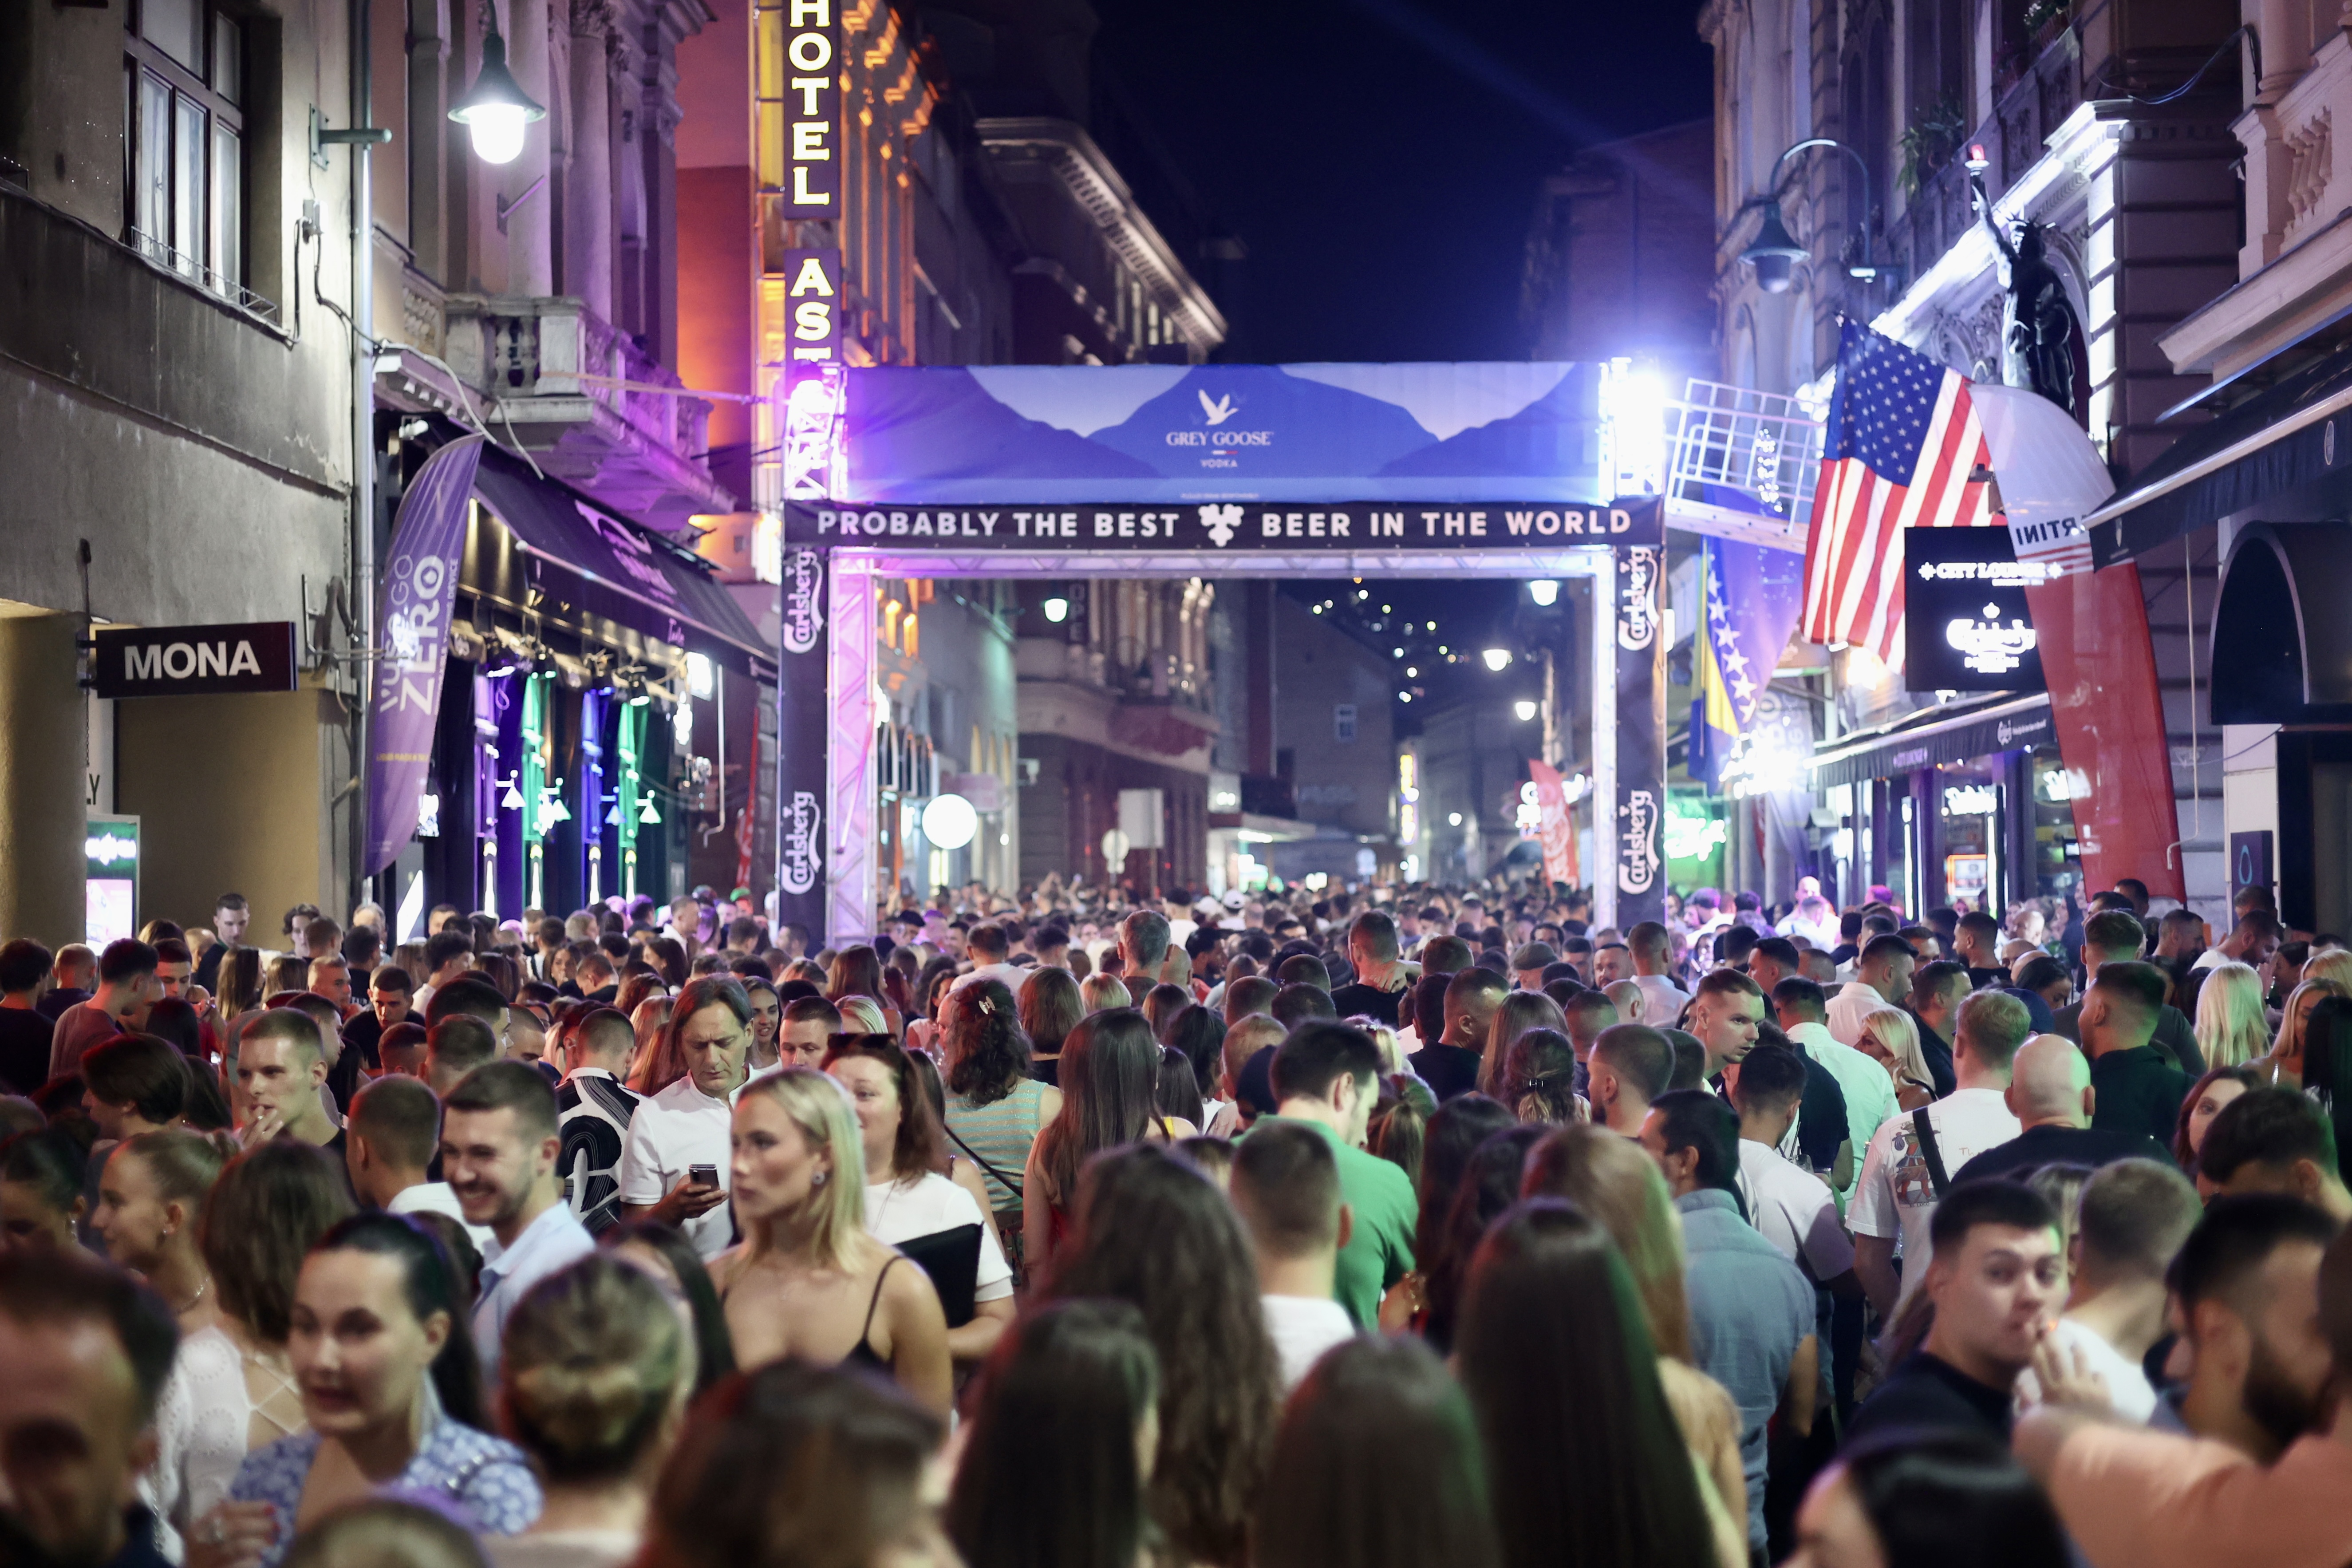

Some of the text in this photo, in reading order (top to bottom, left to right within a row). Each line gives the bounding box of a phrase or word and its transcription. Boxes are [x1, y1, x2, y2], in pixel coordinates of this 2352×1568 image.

[789, 0, 832, 205] HOTEL
[1165, 431, 1272, 446] GREY GOOSE
[1200, 458, 1238, 468] VODKA
[818, 509, 1631, 537] PROBABLY THE BEST BEER IN THE WORLD
[783, 551, 825, 654] Carlsberg
[1618, 545, 1660, 651] Carlsberg
[124, 640, 261, 680] MONA
[781, 790, 822, 895] Carlsberg
[1618, 790, 1661, 895] Carlsberg
